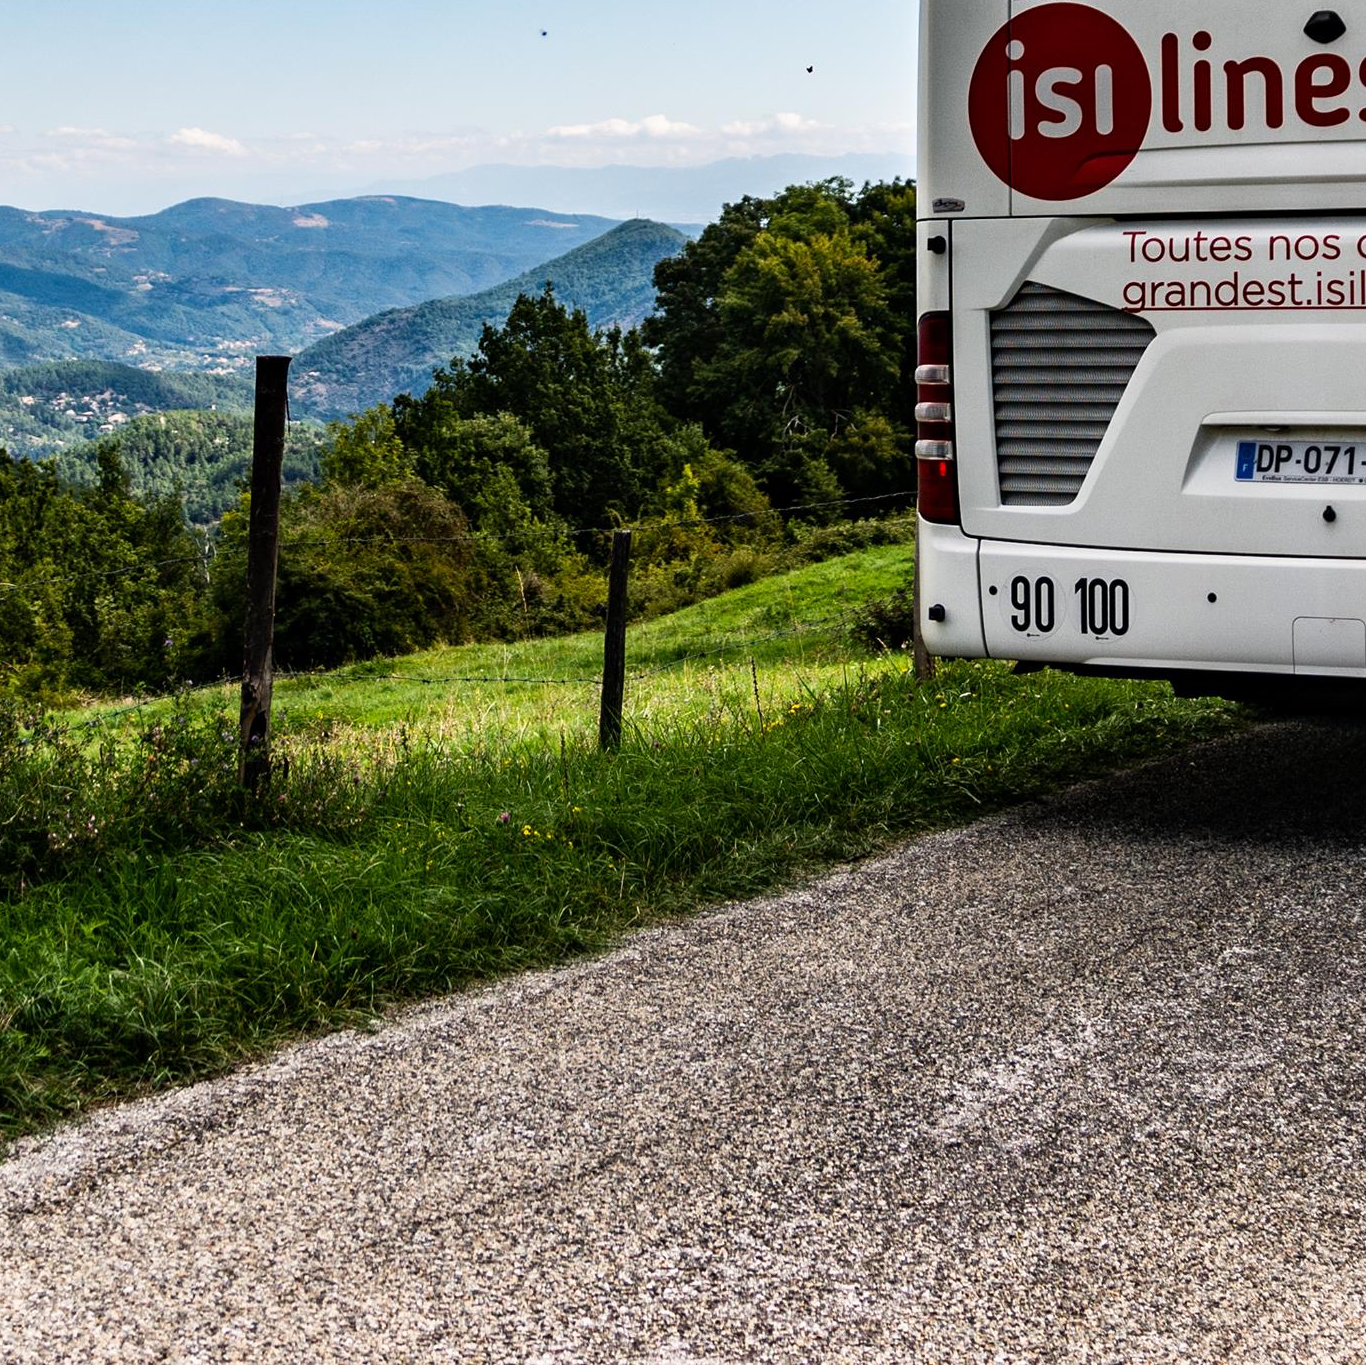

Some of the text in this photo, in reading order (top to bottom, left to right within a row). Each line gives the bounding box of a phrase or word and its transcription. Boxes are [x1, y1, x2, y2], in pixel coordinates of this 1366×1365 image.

[1122, 230, 1252, 263] Toutes
[1269, 233, 1341, 261] nos
[1242, 463, 1248, 472] F
[1011, 575, 1129, 636] 90 100
